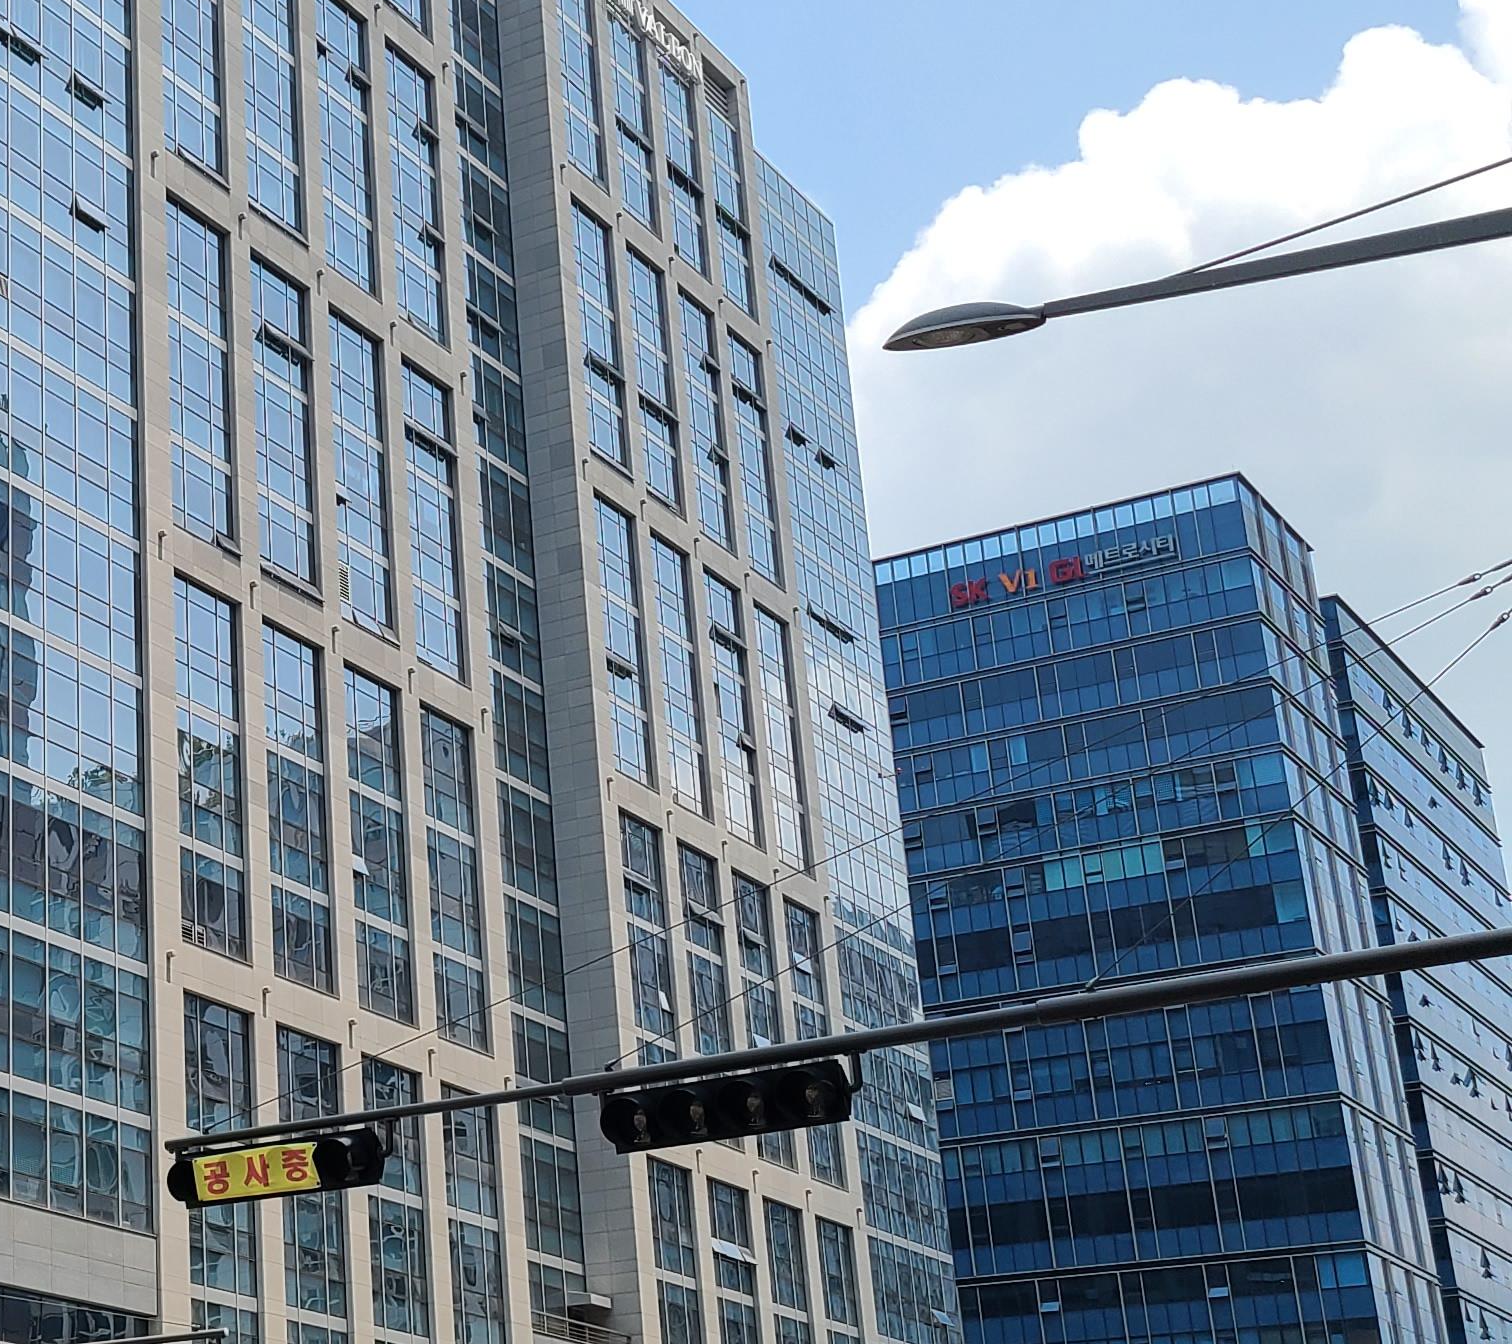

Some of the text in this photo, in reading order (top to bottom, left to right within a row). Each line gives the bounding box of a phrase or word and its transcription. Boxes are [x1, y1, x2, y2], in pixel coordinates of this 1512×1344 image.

[631, 0, 703, 83] VALEON
[951, 577, 990, 606] SK
[999, 568, 1039, 593] V1
[1086, 533, 1175, 569] 메트로시티
[203, 1149, 310, 1195] 공사중
